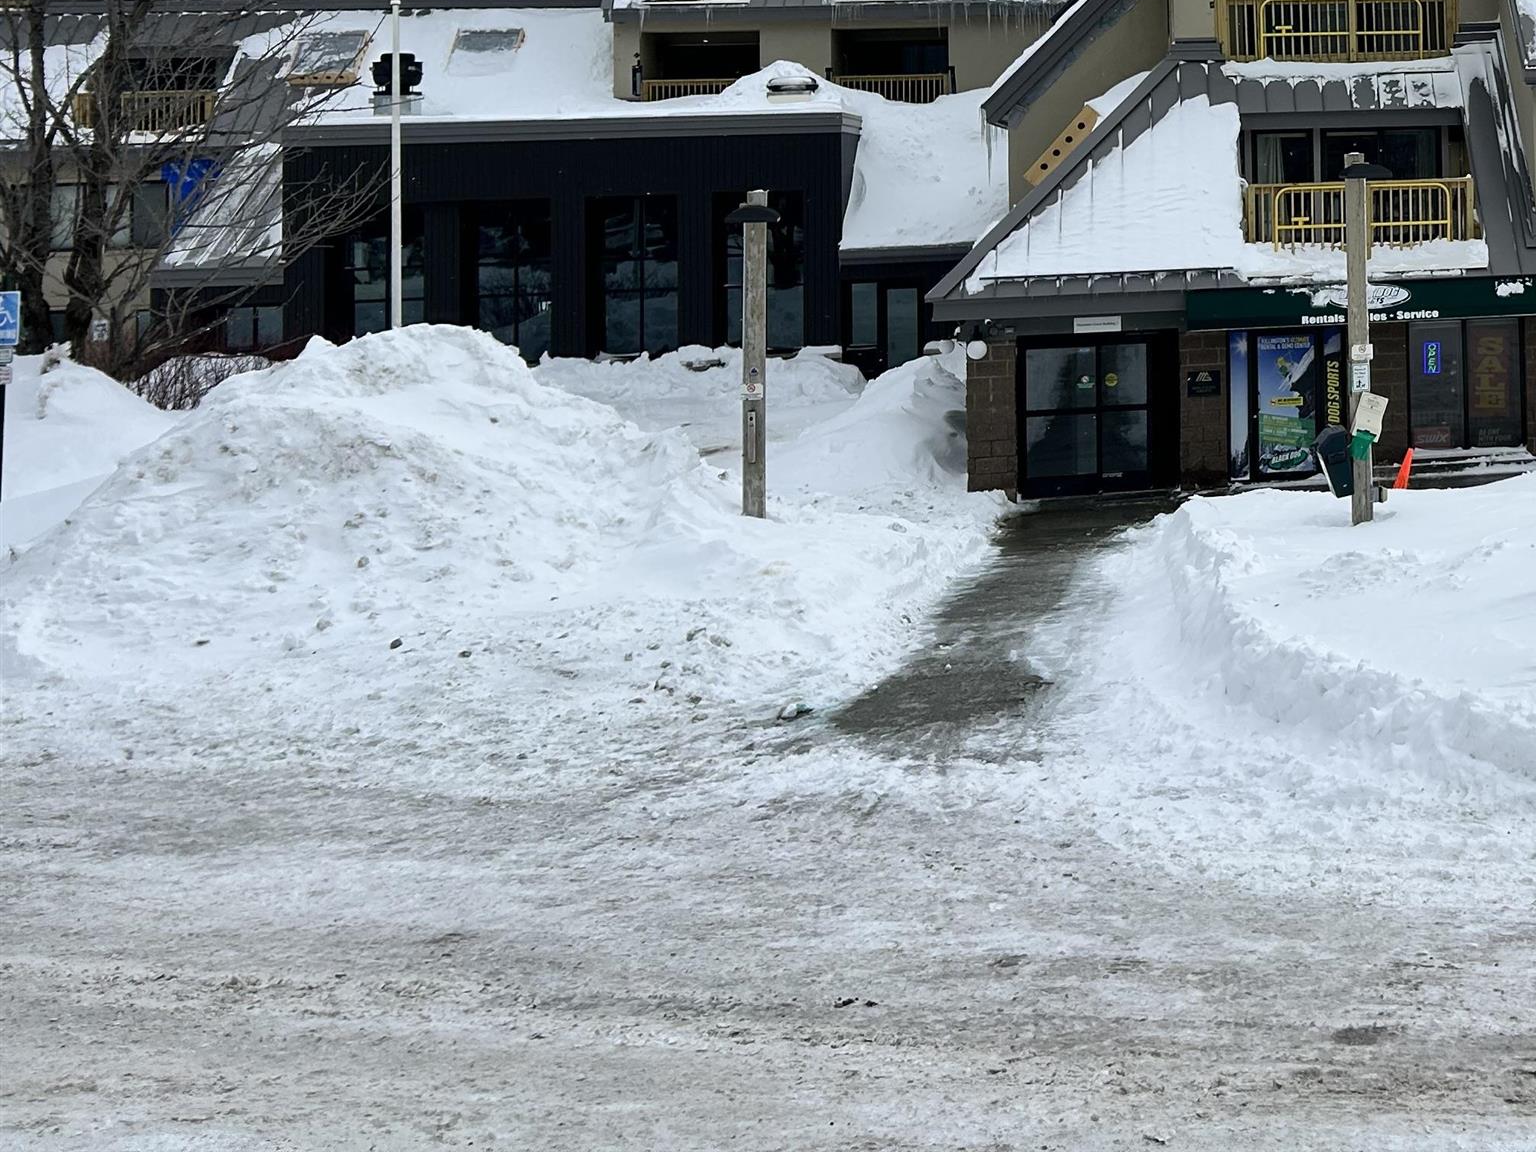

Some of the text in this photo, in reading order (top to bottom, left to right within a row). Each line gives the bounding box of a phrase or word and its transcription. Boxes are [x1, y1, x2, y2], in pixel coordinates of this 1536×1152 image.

[1301, 313, 1345, 325] Rentals
[1396, 309, 1439, 320] Service
[1427, 343, 1437, 373] OPEN
[1474, 337, 1507, 408] SALE
[1327, 360, 1340, 423] DOG SPORTS
